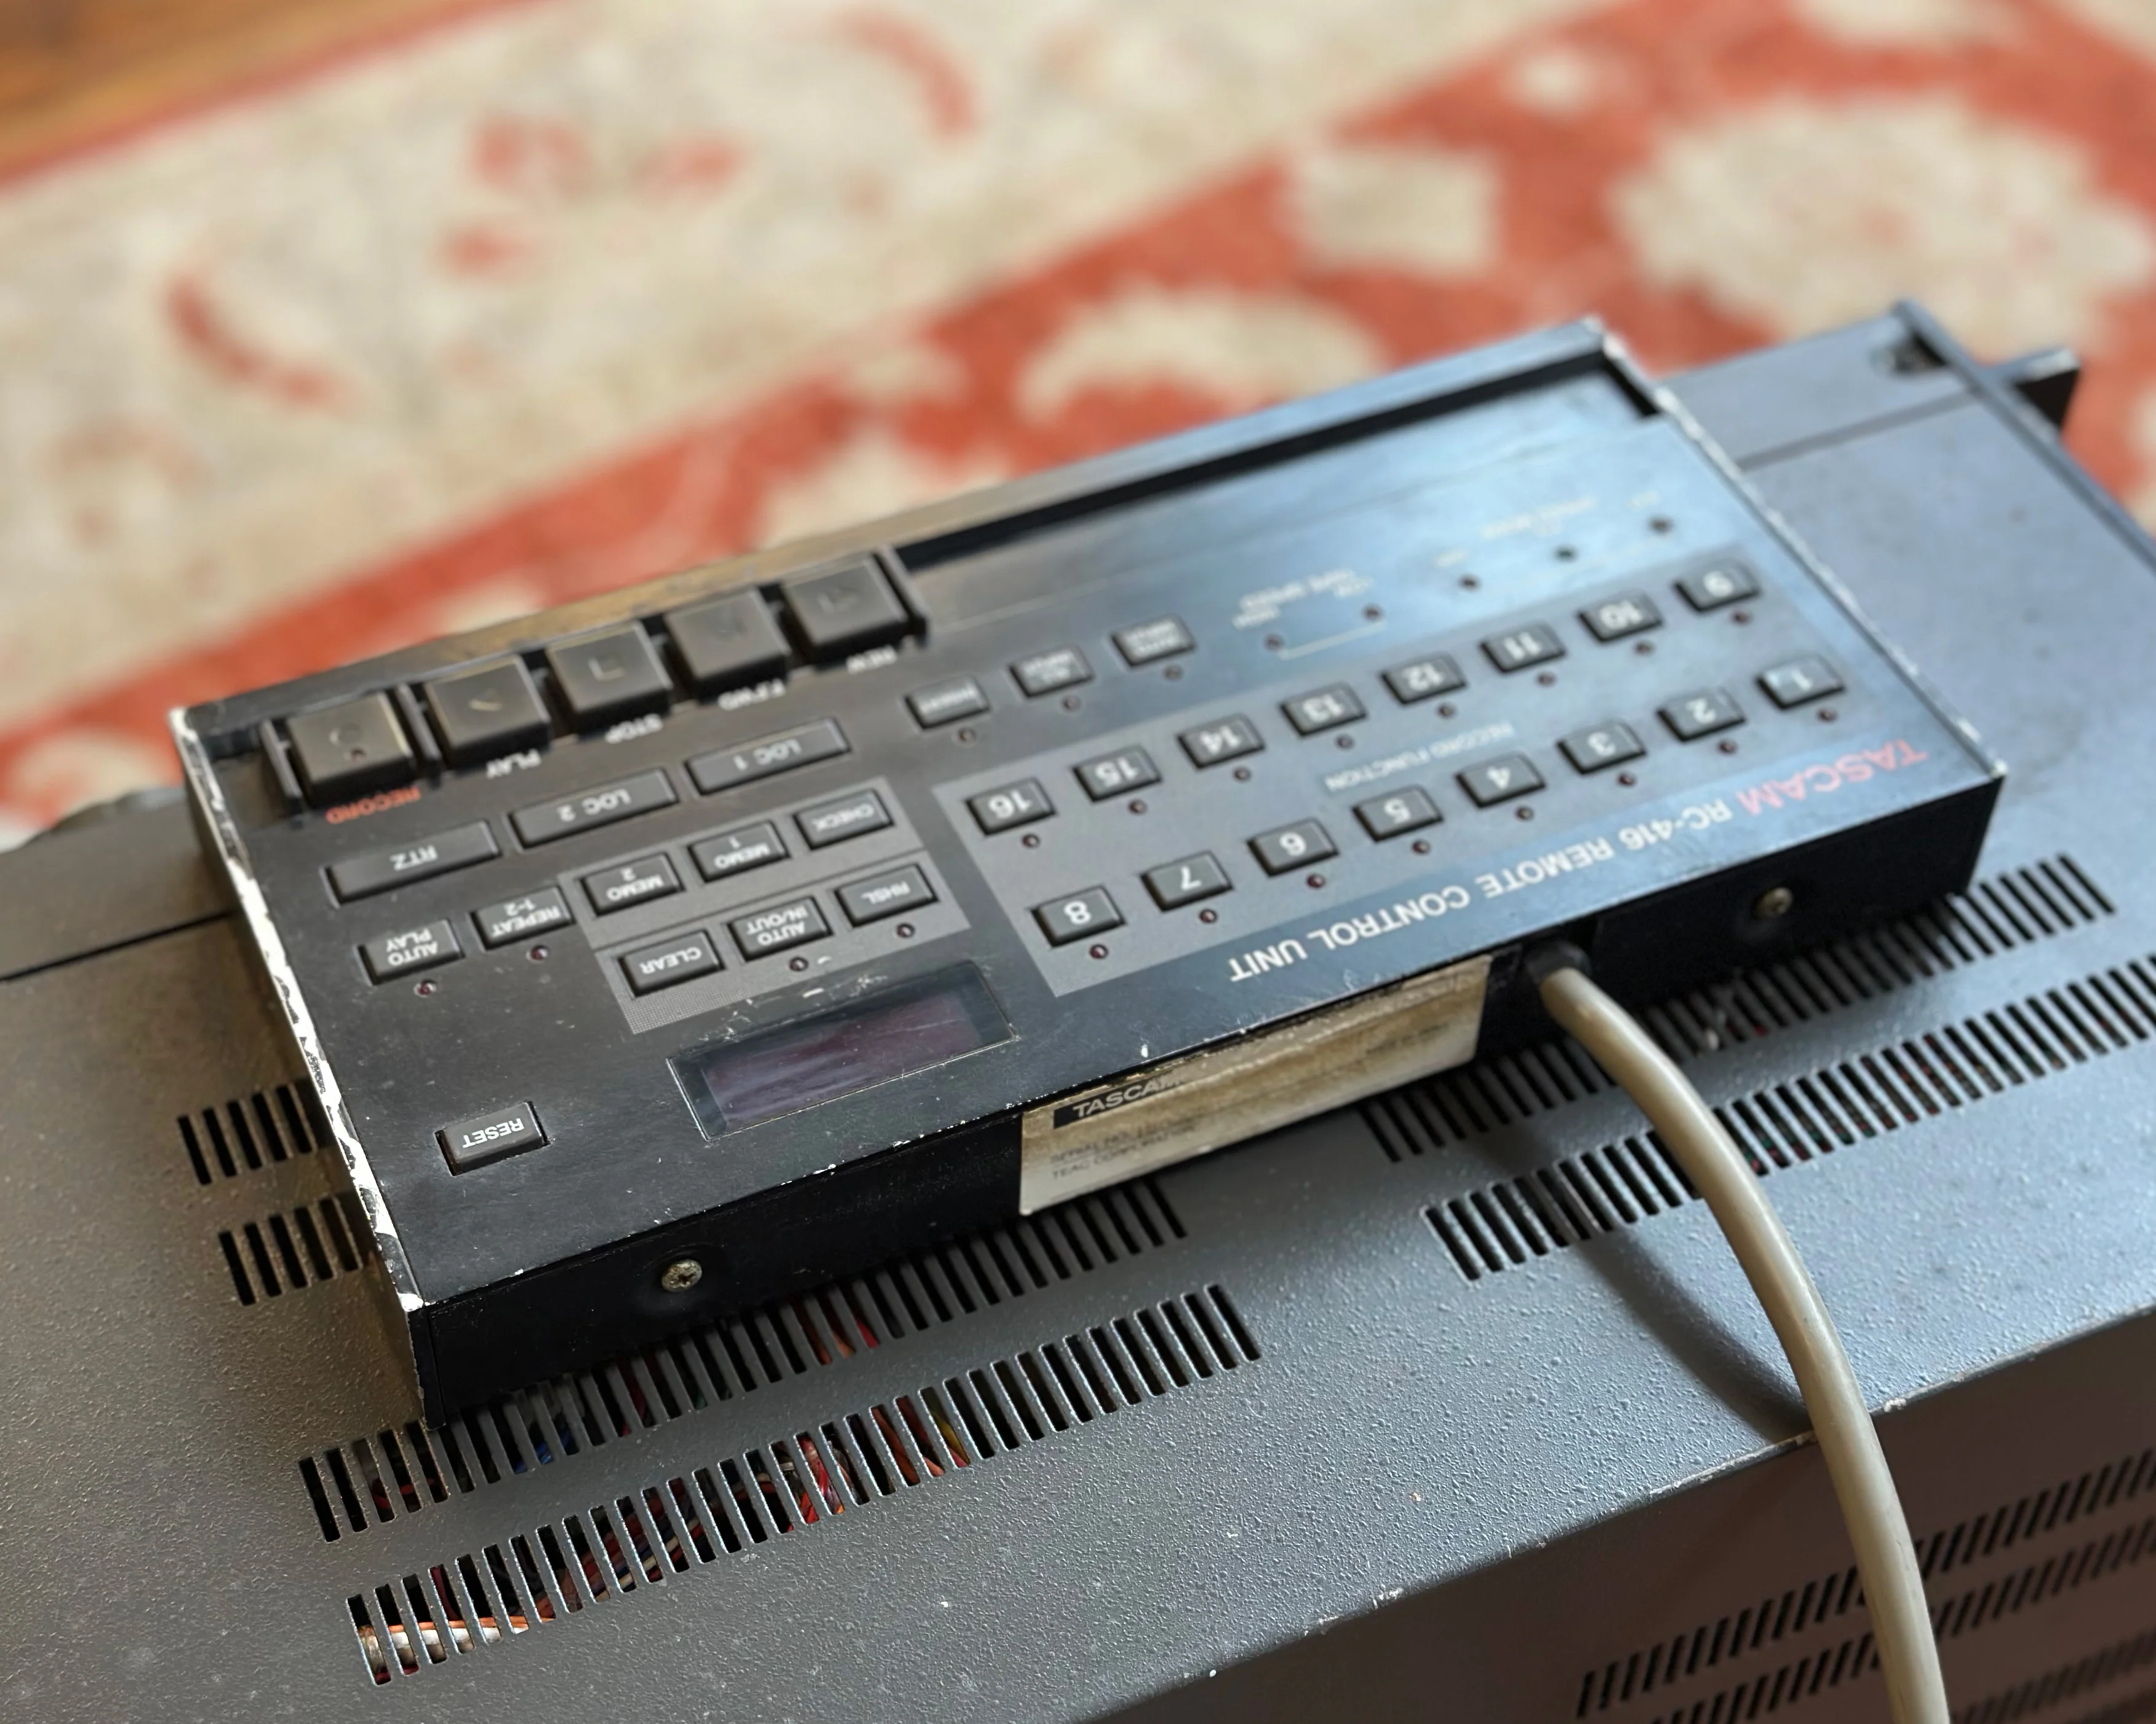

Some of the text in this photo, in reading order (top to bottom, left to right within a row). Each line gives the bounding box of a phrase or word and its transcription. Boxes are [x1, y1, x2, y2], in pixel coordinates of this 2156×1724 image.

[1598, 599, 1644, 631] 10
[1503, 630, 1545, 660] 11
[1400, 662, 1448, 692] 12
[1788, 669, 1814, 692] 1
[1302, 693, 1346, 723] 13
[1685, 698, 1717, 724] 2
[605, 714, 664, 743] STOP
[1203, 724, 1244, 755] 14
[733, 738, 801, 771] LOC 1
[1587, 731, 1616, 757] 3
[485, 749, 542, 778] PLAY
[1095, 757, 1140, 787] 15
[1325, 747, 1431, 792] FUNCTION
[1486, 765, 1513, 790] 4
[325, 786, 421, 824] RECORD
[557, 788, 631, 822] LOC 2
[811, 803, 875, 832] CHECK
[988, 789, 1033, 819] 16
[1383, 798, 1412, 824] 5
[714, 841, 770, 869] MEMO
[729, 837, 743, 849] 1
[1279, 831, 1308, 857] 6
[389, 845, 438, 871] RTZ
[1228, 739, 1929, 983] TASCAM RC-416 REMOTE CONTROL UNIT
[606, 874, 665, 901] MEMO
[620, 868, 636, 882] 2
[1179, 866, 1203, 891] 7
[503, 897, 534, 916] 1-2
[861, 880, 910, 905] RHSL
[491, 904, 561, 937] REPEAT
[745, 905, 809, 935] IN/OUT
[1063, 900, 1092, 926] 8
[385, 927, 432, 953] PLAY
[757, 921, 806, 946] AUTO
[388, 940, 439, 967] AUTO
[639, 946, 703, 975] CLEAR
[462, 1118, 525, 1149] RESET
